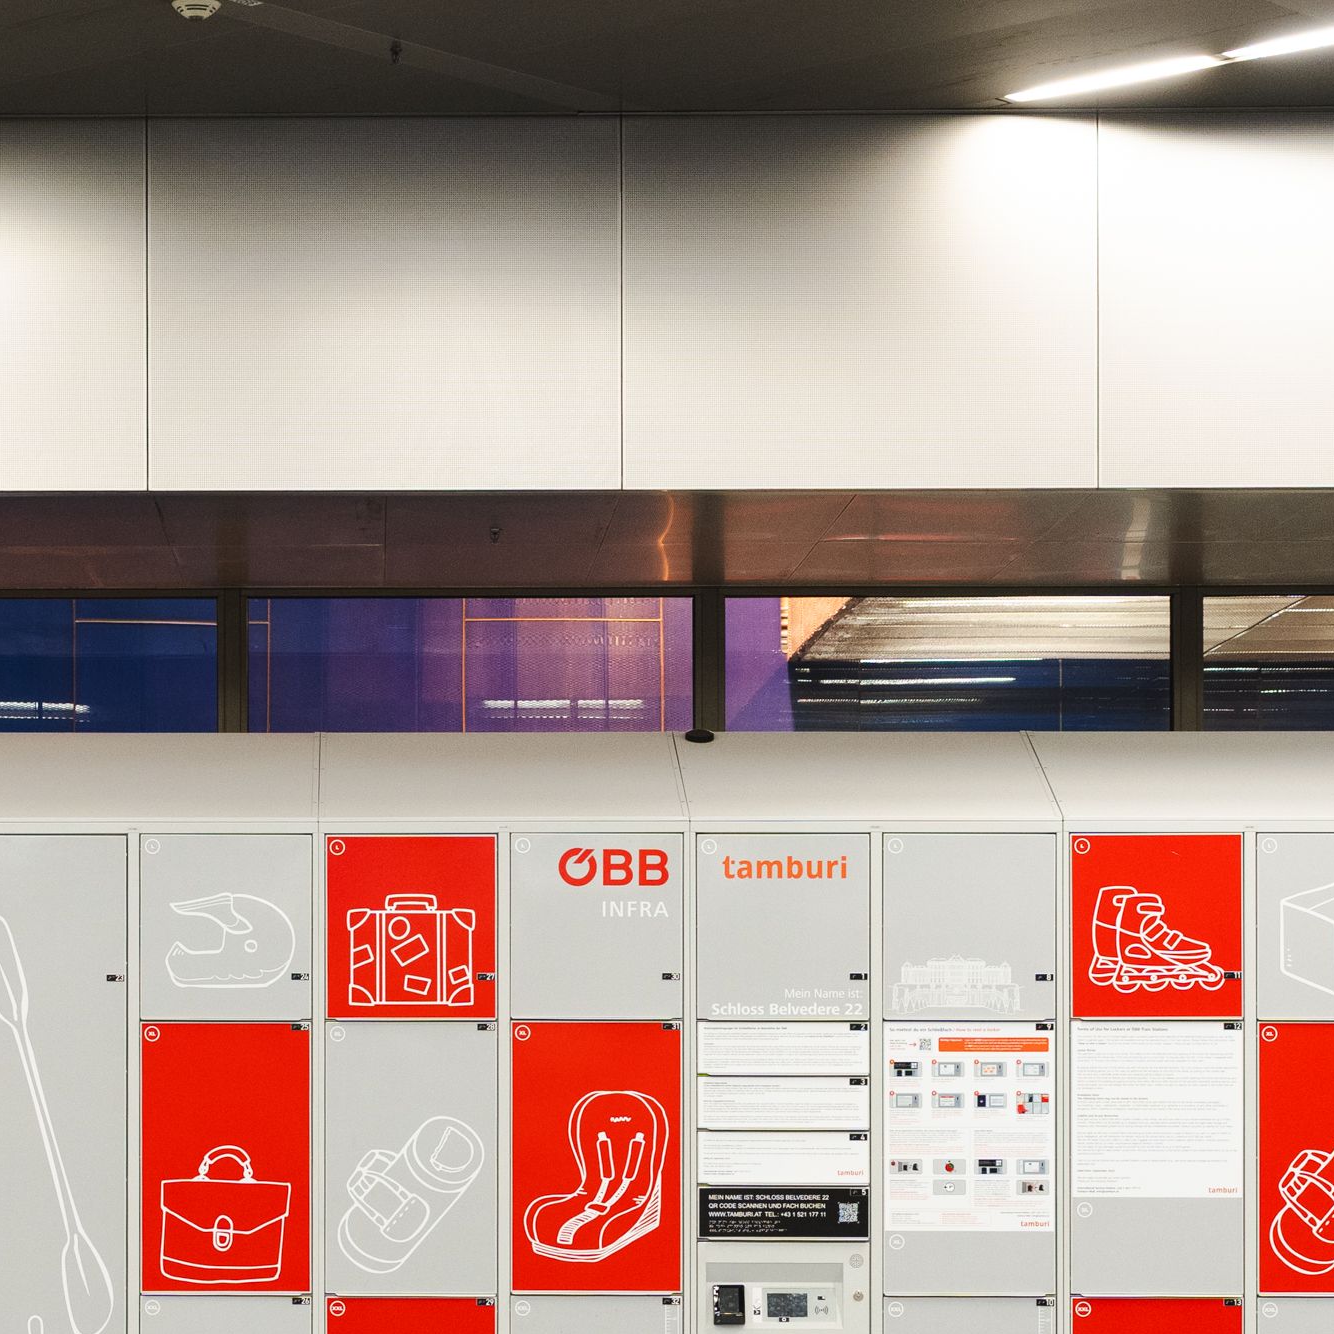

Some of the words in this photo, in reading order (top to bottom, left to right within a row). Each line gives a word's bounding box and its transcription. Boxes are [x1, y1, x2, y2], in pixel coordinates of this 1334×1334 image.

[559, 847, 669, 886] ÖBB
[722, 856, 847, 879] tamburi
[602, 901, 669, 917] INFRA
[785, 989, 810, 998] Mein
[815, 989, 845, 998] Name
[848, 989, 863, 998] ist:
[712, 1003, 764, 1015] Schloss
[769, 1003, 840, 1015] Belvedere
[845, 1003, 863, 1015] 22
